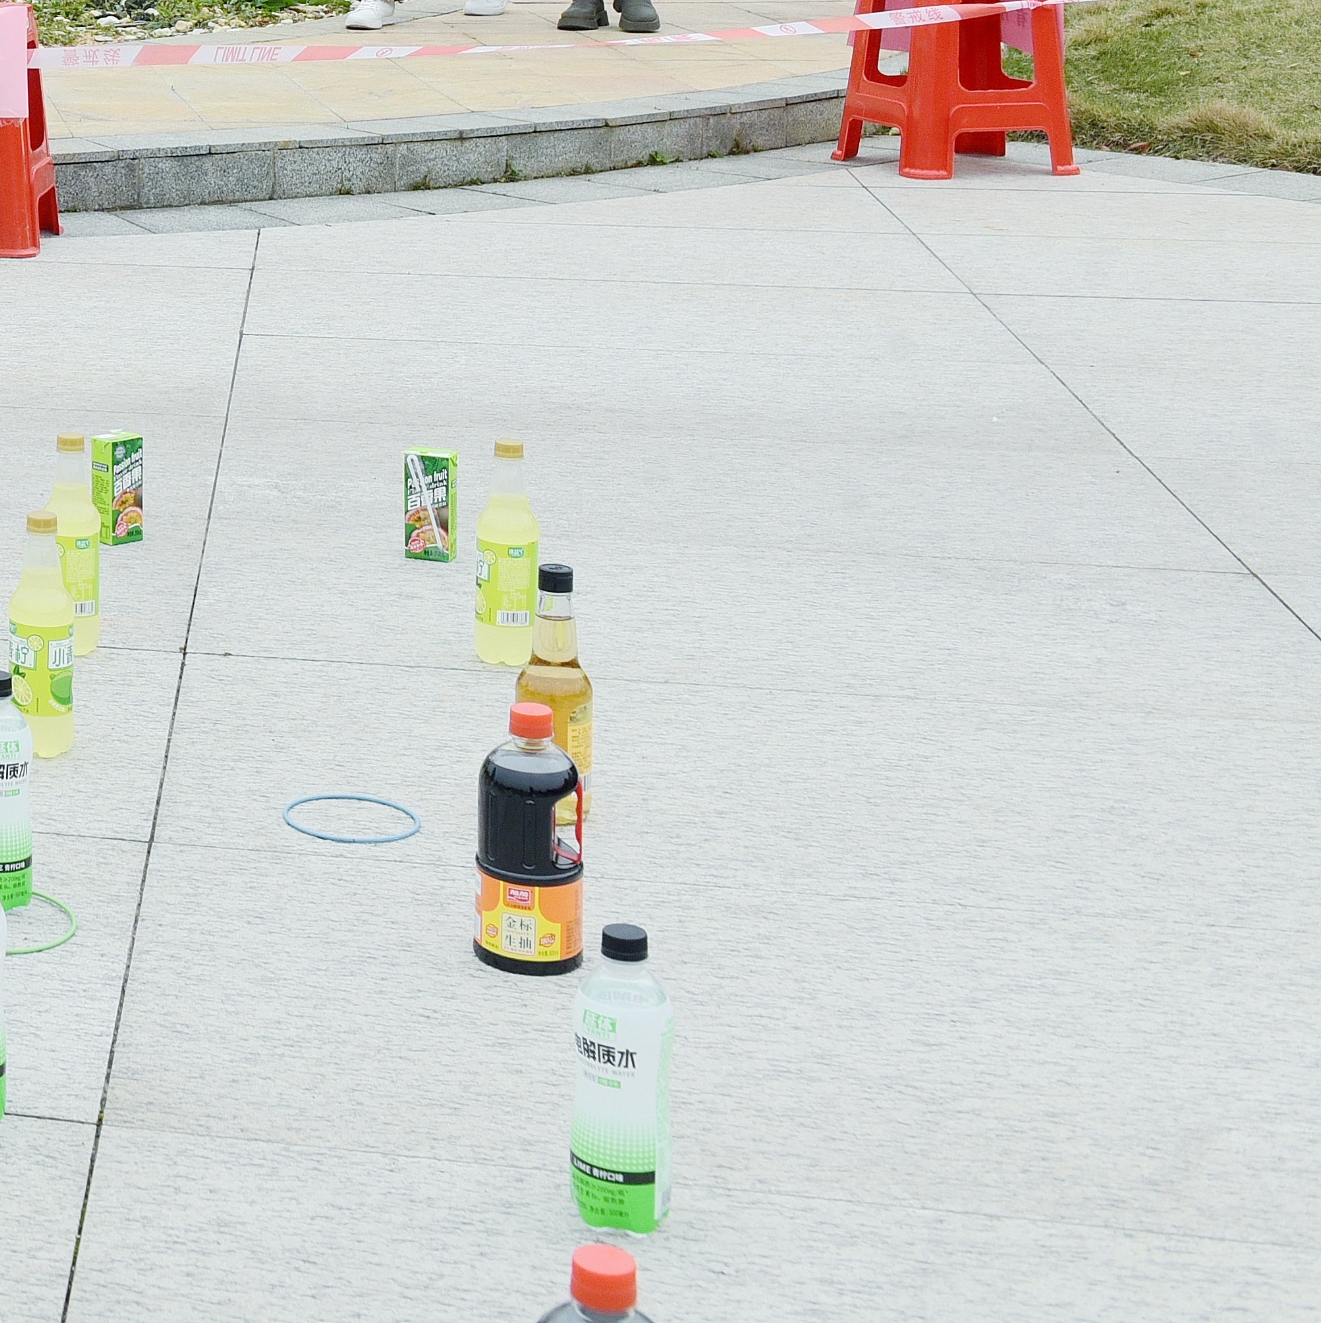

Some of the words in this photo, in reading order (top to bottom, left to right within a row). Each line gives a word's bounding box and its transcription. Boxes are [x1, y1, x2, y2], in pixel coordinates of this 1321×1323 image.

[887, 6, 945, 25] 警戒线
[505, 916, 533, 932] 金标
[505, 934, 532, 950] 生抽
